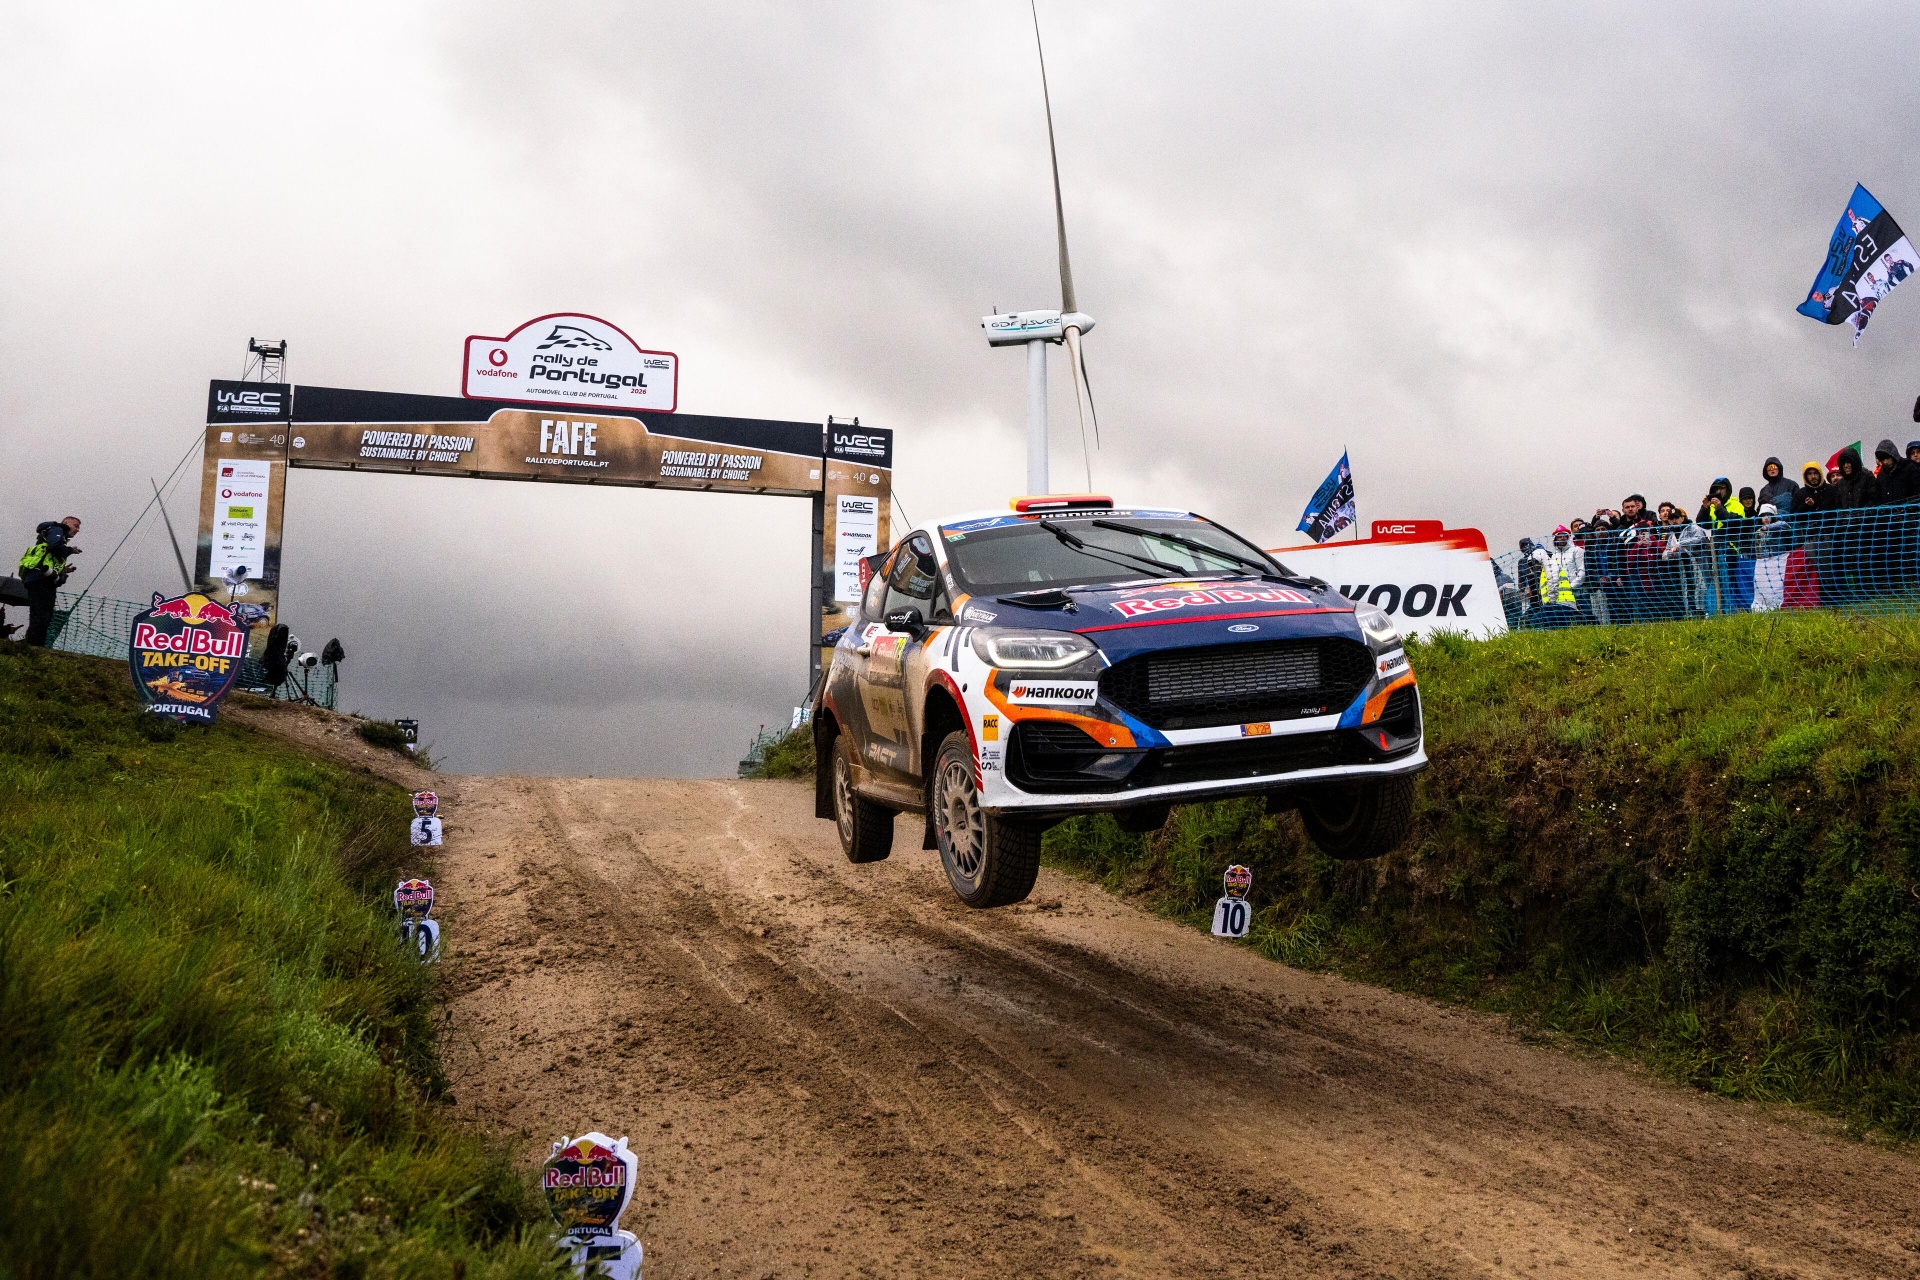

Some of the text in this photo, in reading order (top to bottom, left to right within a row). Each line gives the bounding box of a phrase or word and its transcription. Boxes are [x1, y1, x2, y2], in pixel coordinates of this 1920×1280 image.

[991, 320, 1019, 328] GDF
[532, 353, 598, 367] rally de
[643, 358, 670, 367] WRC
[476, 368, 518, 379] vodafone
[529, 364, 648, 390] Portugal
[217, 389, 282, 406] WRC
[526, 387, 562, 397] AUTOMÓVEL
[562, 390, 578, 398] CLUB
[587, 392, 619, 400] PORTUGAL
[269, 434, 285, 445] 40
[360, 430, 475, 452] POWERED BY PASSION
[539, 419, 598, 456] FAFE
[833, 432, 886, 449] WRC
[360, 446, 460, 463] SUSTAINABLE BY CHOICE
[660, 450, 763, 470] POWERED BY PASSION
[525, 456, 610, 468] RALLYDEPORTUGAL.PT
[660, 465, 750, 481] SUSTAINABLE BY CHOICE
[852, 472, 866, 482] 40
[233, 490, 263, 498] vodafone
[841, 500, 874, 510] WRC
[1377, 524, 1416, 534] WRC
[1109, 589, 1314, 619] Red Bull
[1232, 624, 1254, 632] Ford
[134, 622, 191, 652] Red
[191, 629, 245, 658] Bull
[142, 651, 230, 675] TAKE-OFF
[1026, 686, 1096, 700] HANKOOK
[145, 703, 211, 719] PORTUGAL
[983, 718, 998, 729] RACC
[420, 820, 433, 844] 5
[415, 889, 432, 900] Bull
[1222, 902, 1246, 935] 10
[546, 1165, 625, 1188] Red Bull
[566, 1226, 611, 1236] ORTUGAL
